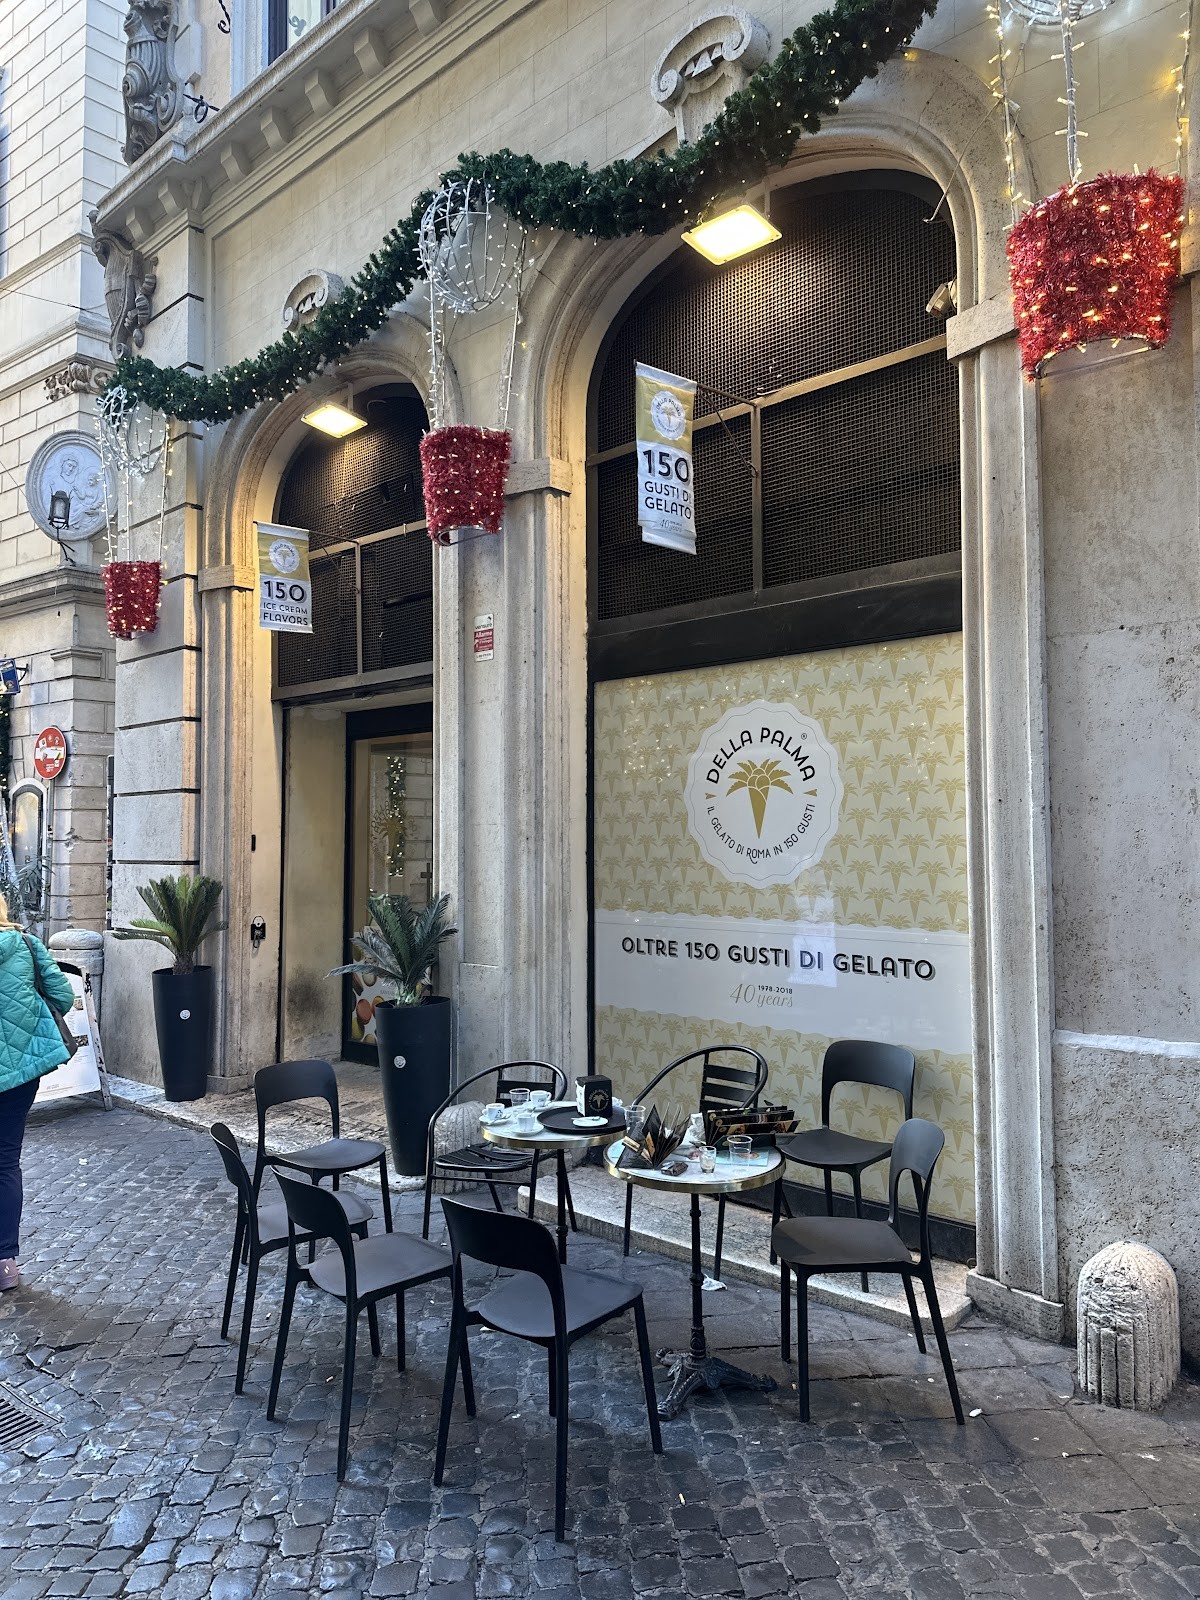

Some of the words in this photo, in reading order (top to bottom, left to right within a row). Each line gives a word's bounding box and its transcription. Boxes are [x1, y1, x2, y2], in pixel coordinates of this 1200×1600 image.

[643, 449, 690, 485] 150
[644, 481, 679, 500] GUSTI
[644, 496, 692, 520] GELATO
[263, 580, 306, 602] 150
[263, 602, 277, 611] ICE
[278, 604, 308, 615] CREAM
[263, 612, 309, 626] FLAVORS
[706, 729, 753, 784] DELLA
[760, 727, 816, 782] PALMA
[706, 805, 715, 815] IL
[711, 817, 735, 849] GELATO
[736, 843, 745, 856] DI
[746, 847, 771, 864] ROMA
[773, 843, 783, 856] IN
[784, 833, 799, 850] 150
[797, 803, 816, 834] GUSTI
[622, 937, 678, 957] OLTRE
[685, 942, 720, 961] 150
[728, 945, 790, 969] GUSTI
[800, 950, 823, 971] DI
[833, 953, 936, 981] GELATO
[730, 983, 756, 1004] 40
[756, 993, 793, 1008] years
